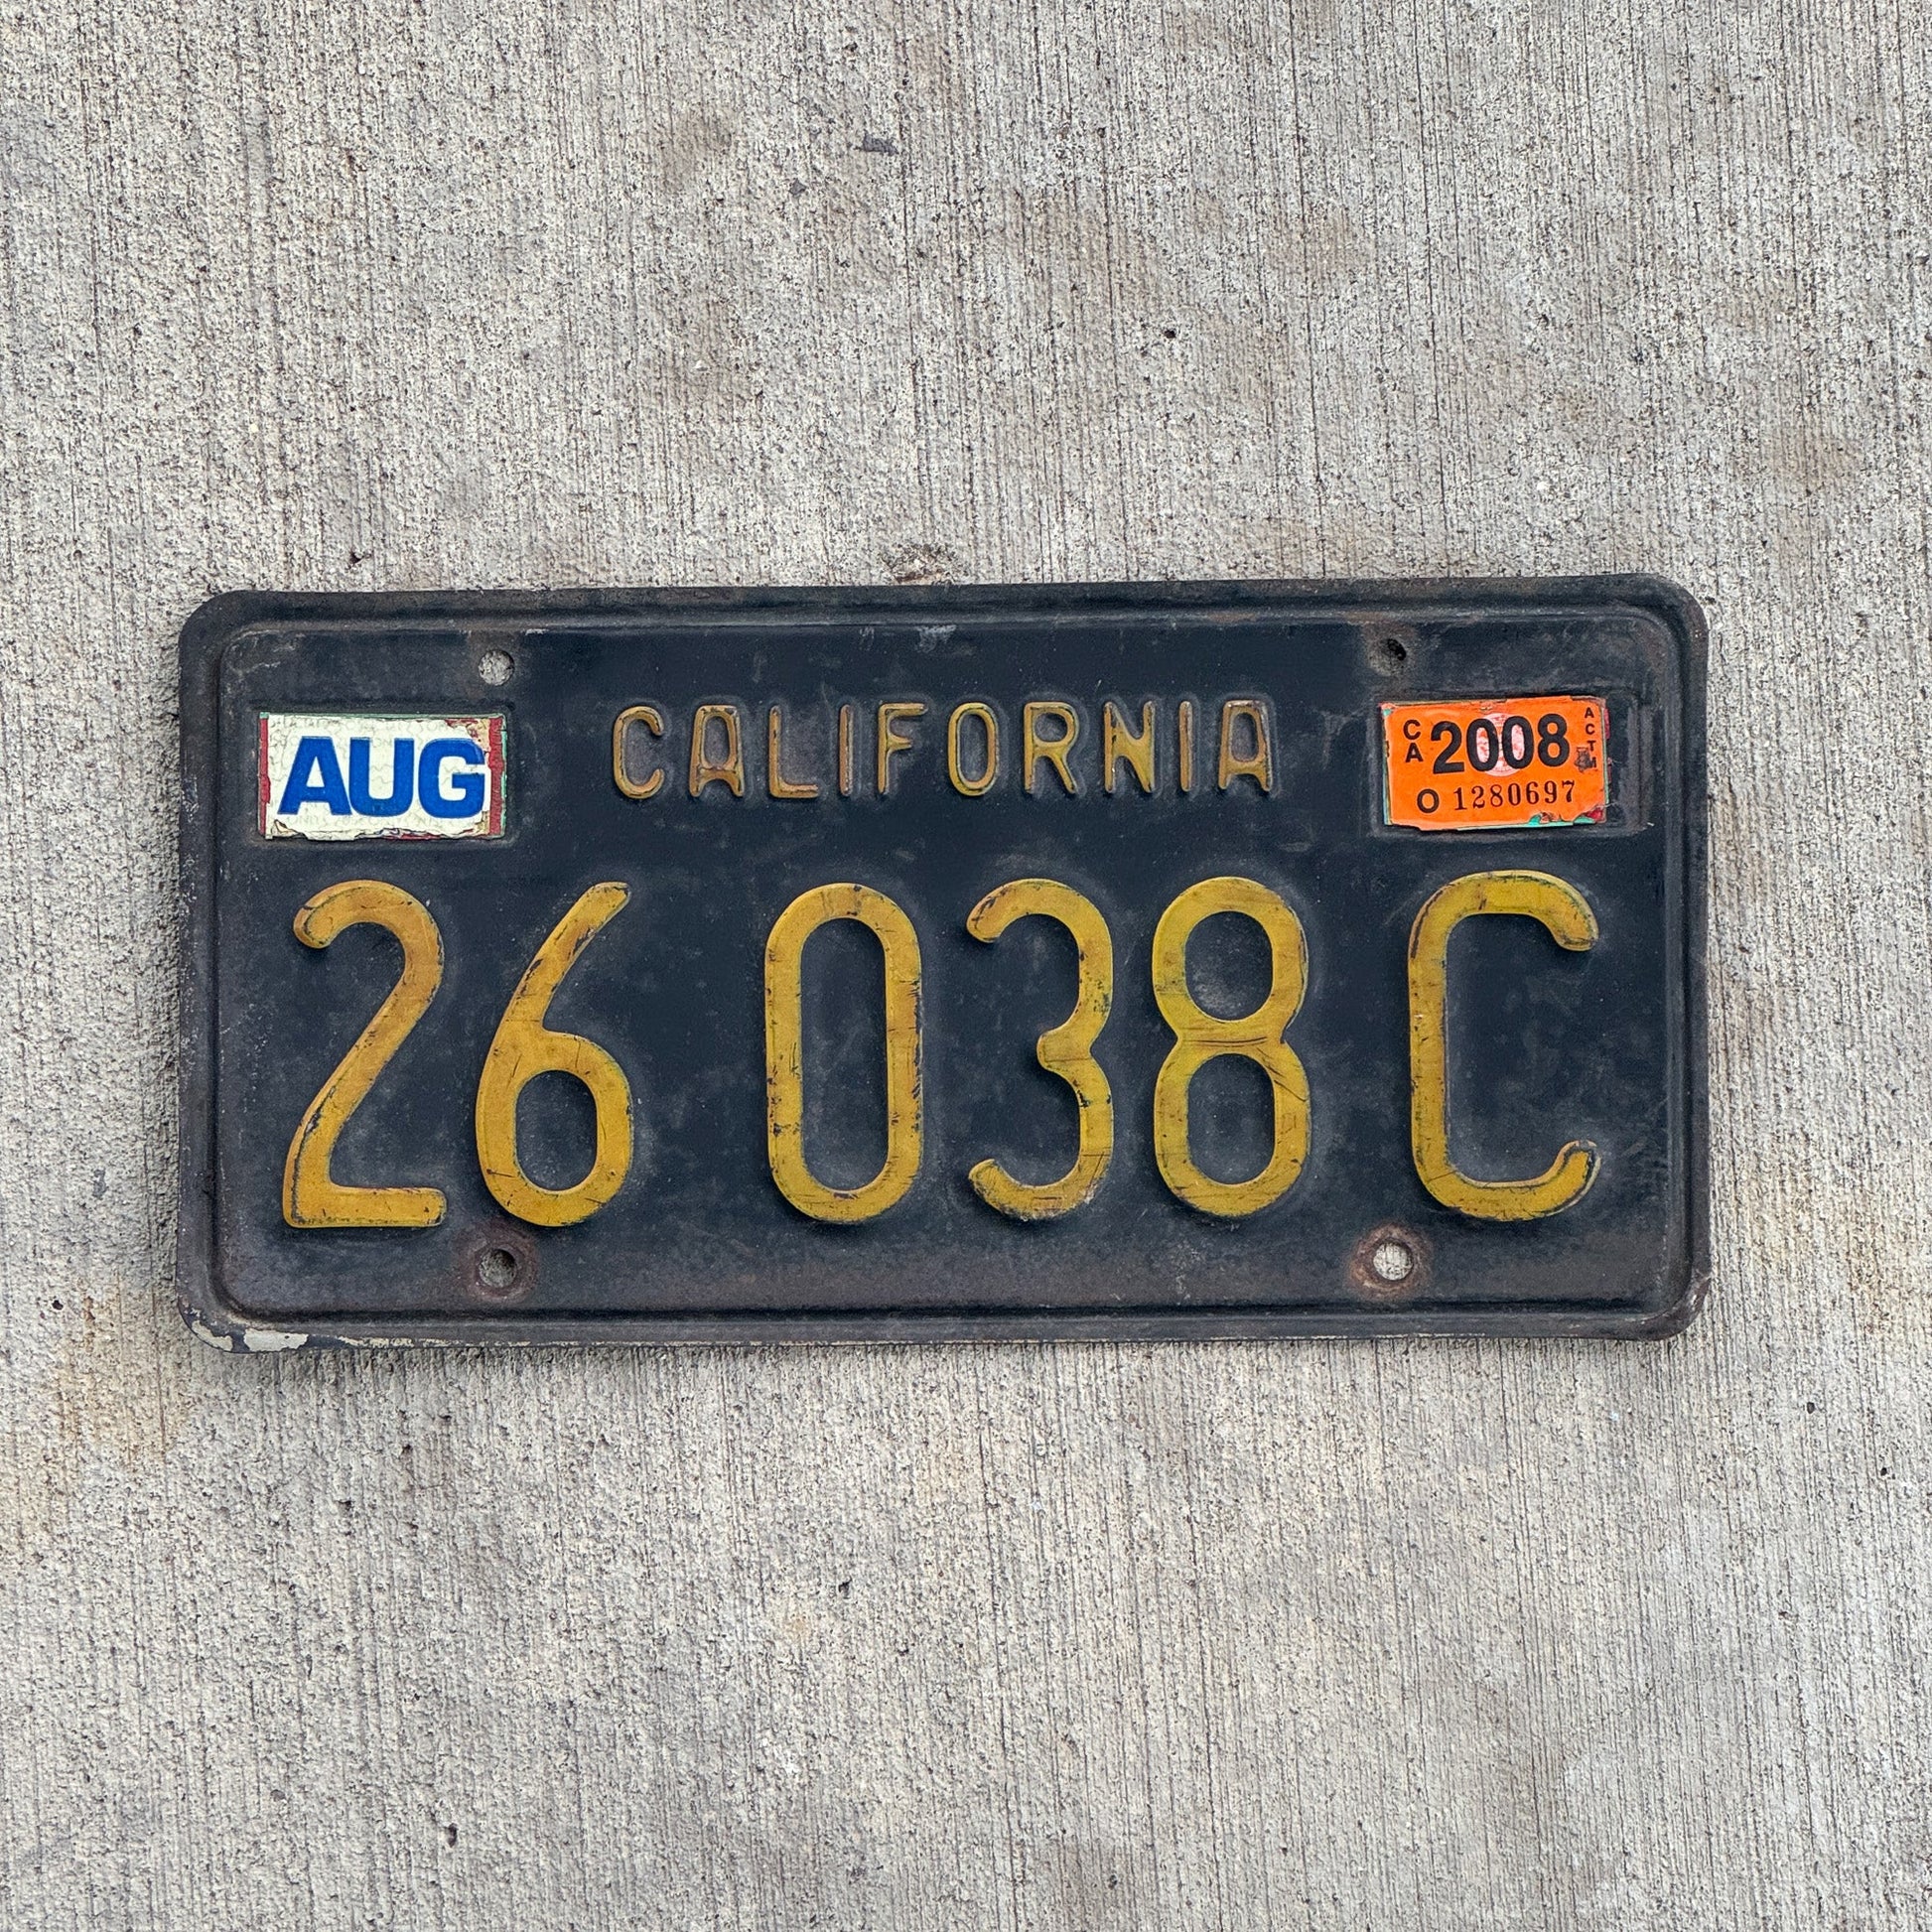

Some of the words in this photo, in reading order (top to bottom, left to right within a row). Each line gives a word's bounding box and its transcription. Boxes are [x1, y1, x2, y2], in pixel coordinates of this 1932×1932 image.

[277, 736, 485, 819] AUG
[612, 700, 1274, 797] CALIFORNIA
[1431, 713, 1571, 774] 2008
[1452, 779, 1576, 811] 1280697
[282, 880, 635, 1228] 26
[765, 877, 1311, 1224] 038
[1407, 870, 1600, 1221] C
